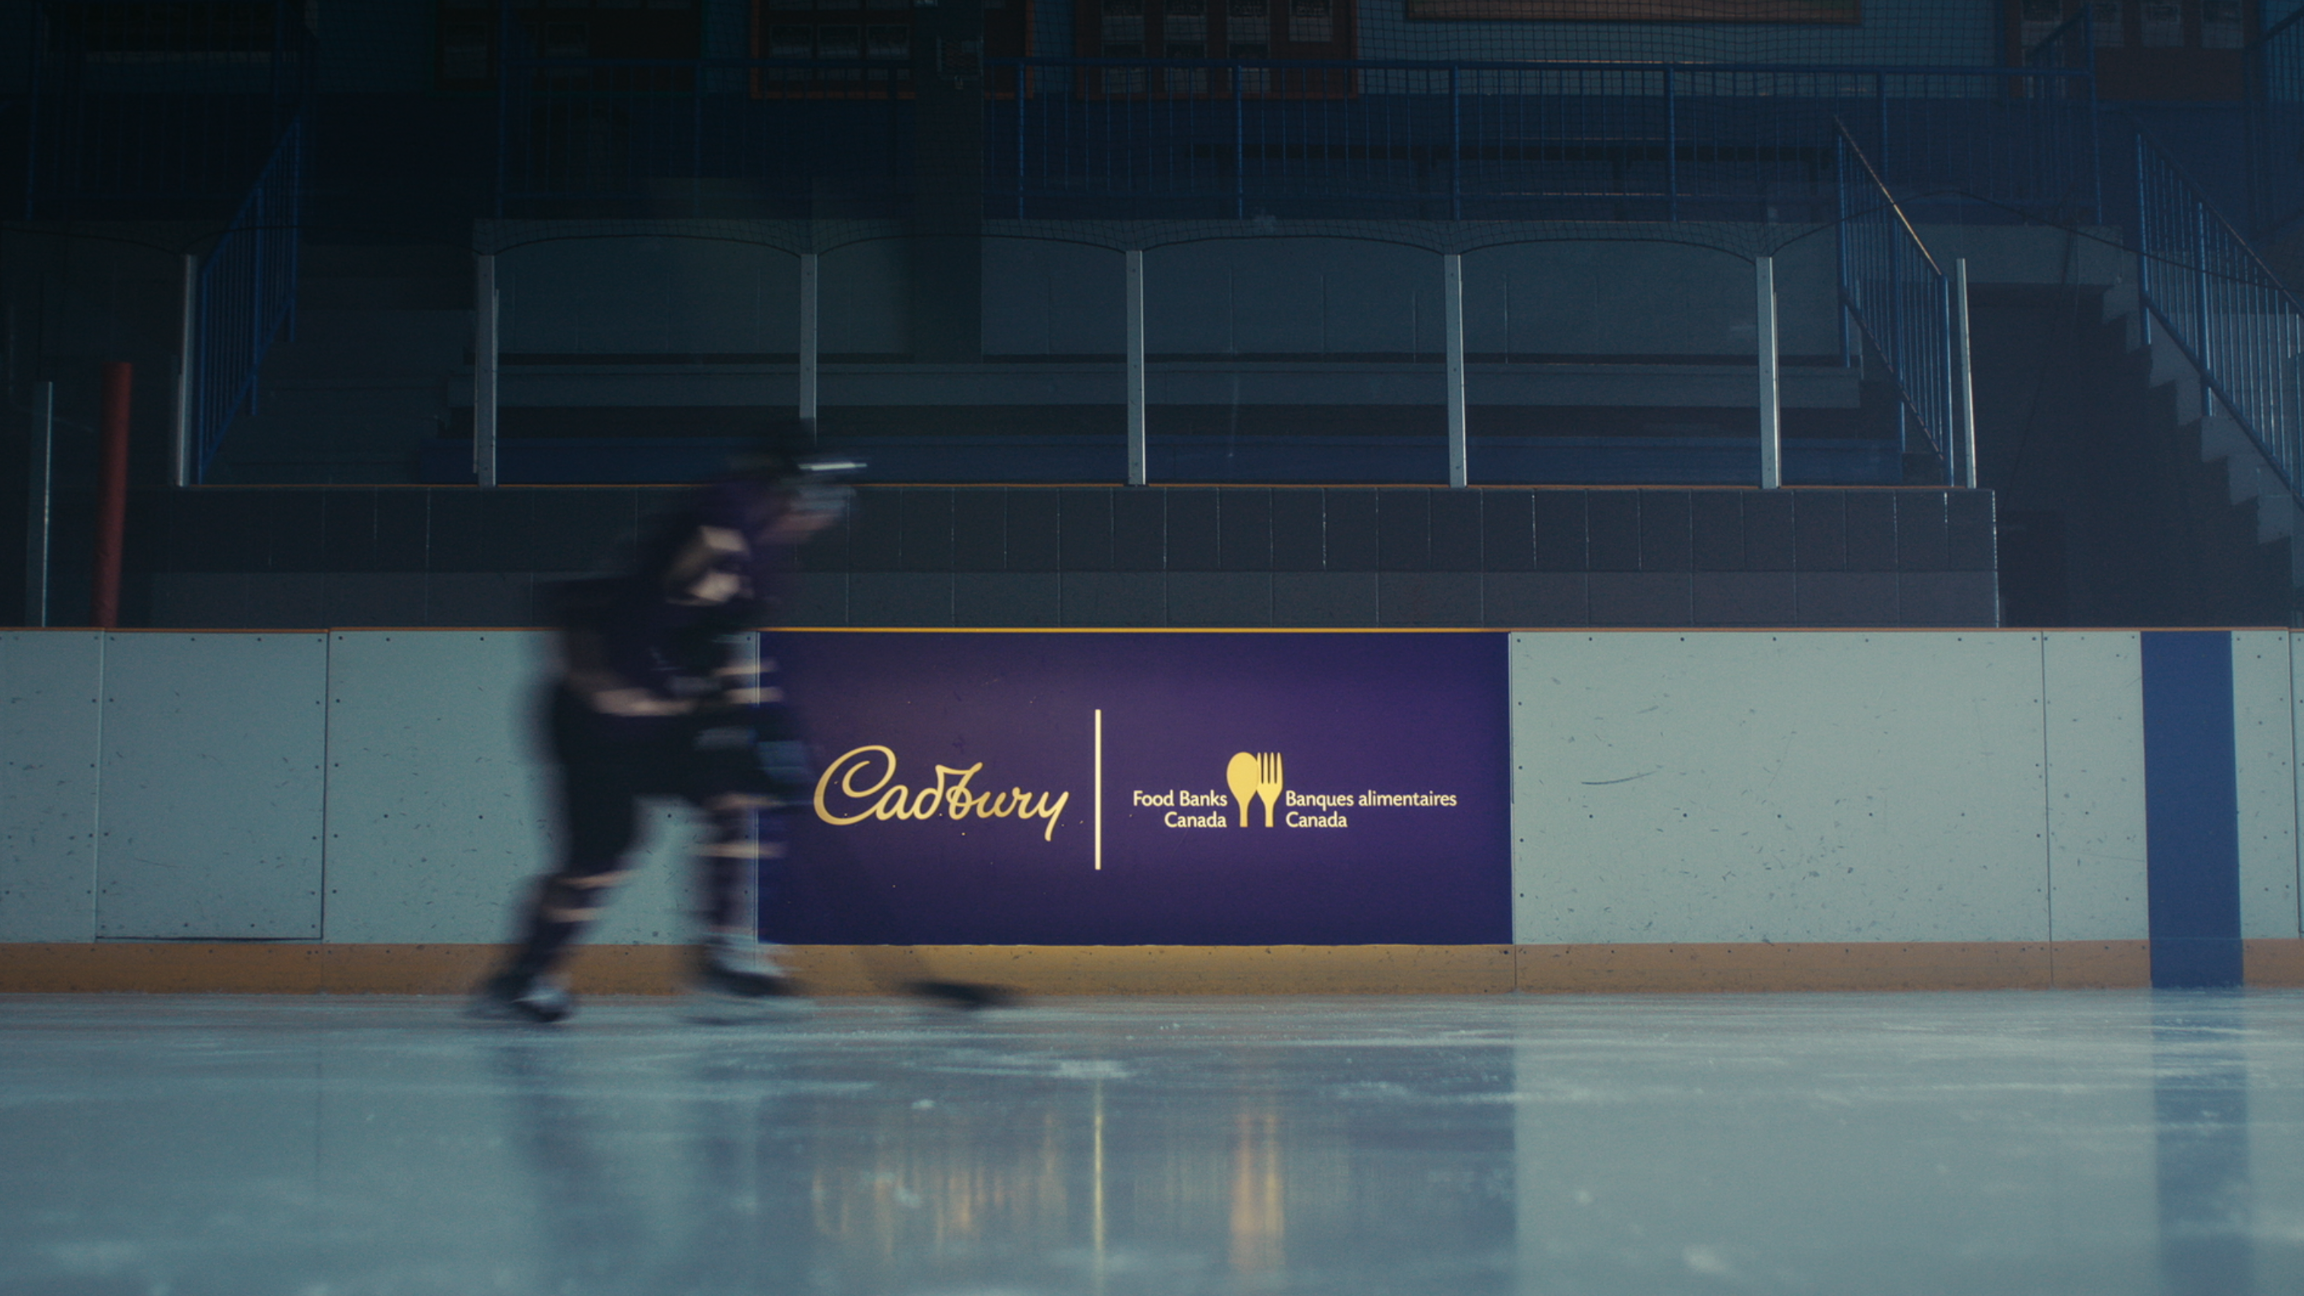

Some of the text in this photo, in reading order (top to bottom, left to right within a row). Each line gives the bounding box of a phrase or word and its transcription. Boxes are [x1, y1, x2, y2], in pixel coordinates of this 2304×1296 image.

[812, 744, 1069, 842] Cadbury
[1132, 789, 1228, 807] Food Banks
[1285, 789, 1458, 811] Banques alimentaires
[1164, 810, 1228, 828] Canada
[1285, 810, 1348, 828] Canada
